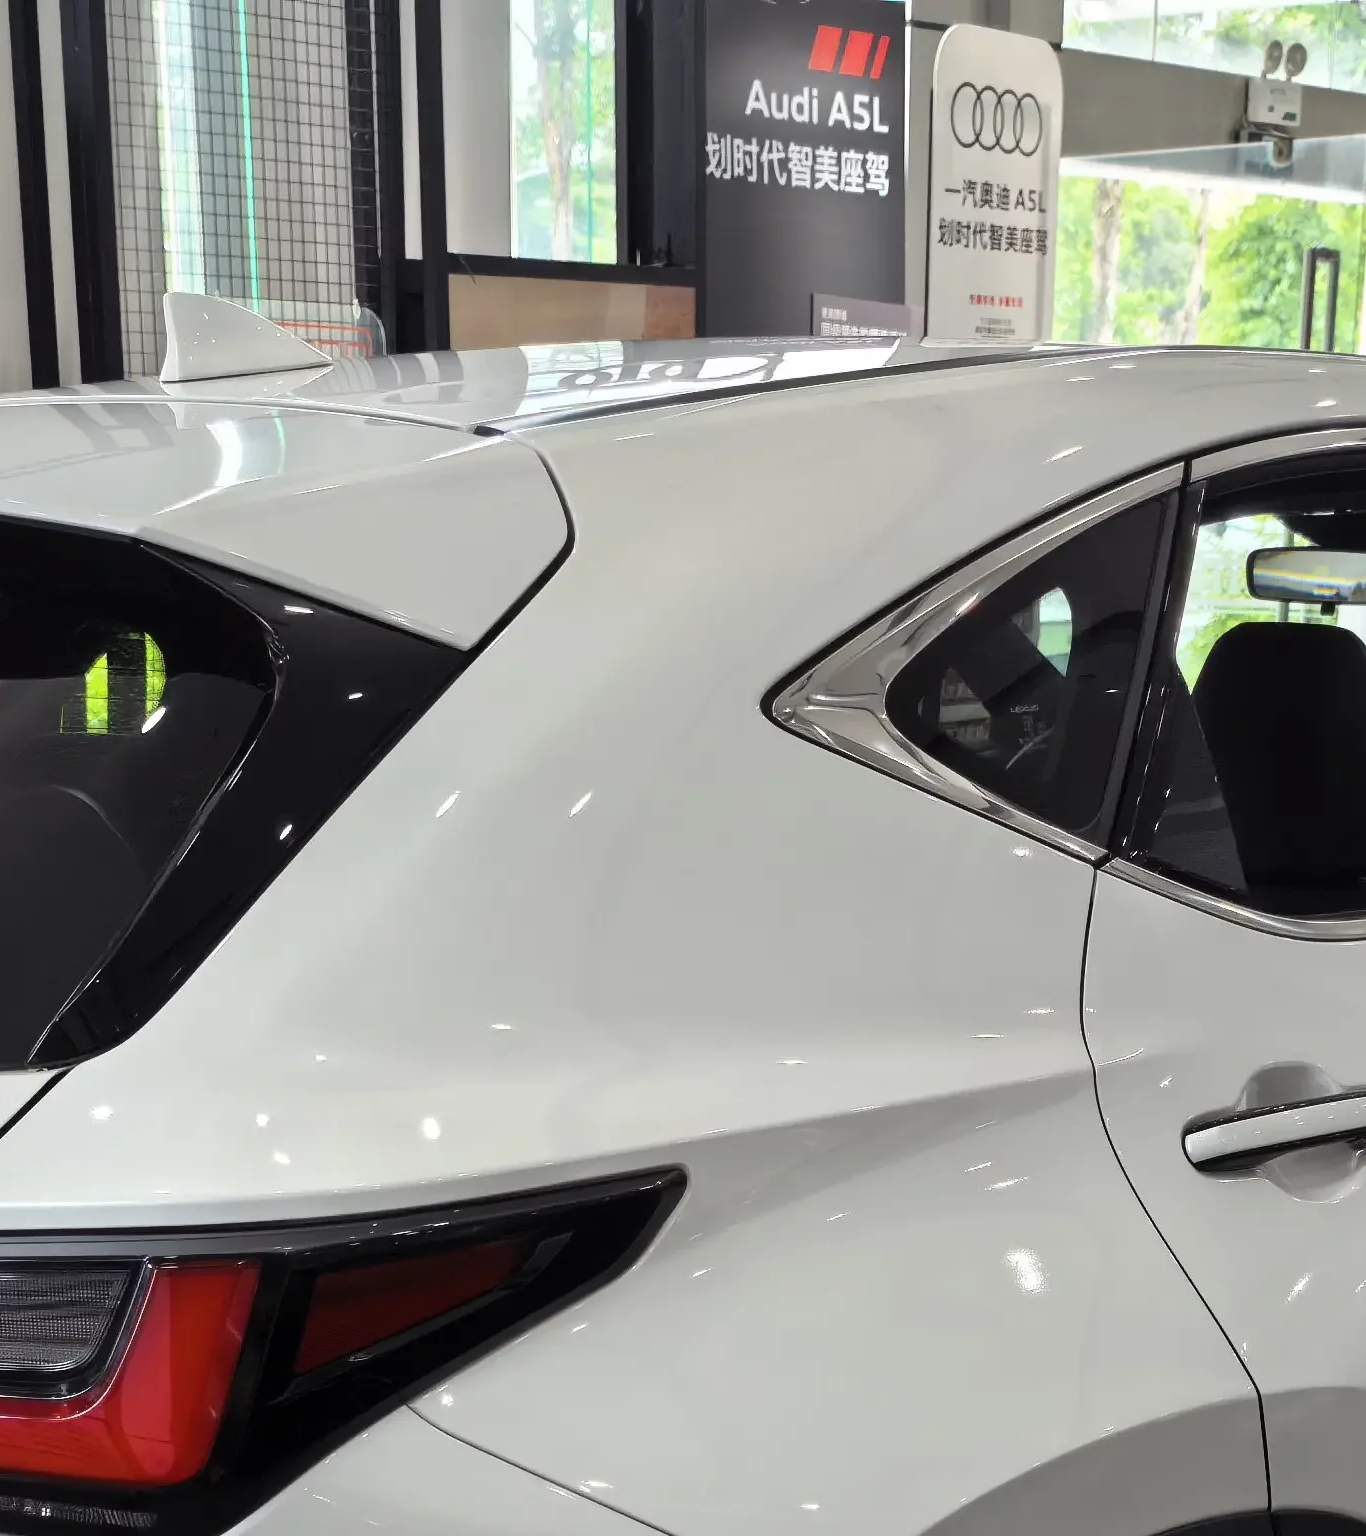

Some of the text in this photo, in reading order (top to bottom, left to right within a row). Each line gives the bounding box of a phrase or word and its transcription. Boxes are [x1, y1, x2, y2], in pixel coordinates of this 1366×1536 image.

[744, 78, 890, 134] Audi A5L
[705, 131, 890, 197] 划时代智美座驾
[944, 179, 1047, 214] 一汽奥迪 A5L
[937, 217, 1048, 256] 划时代智美座驾
